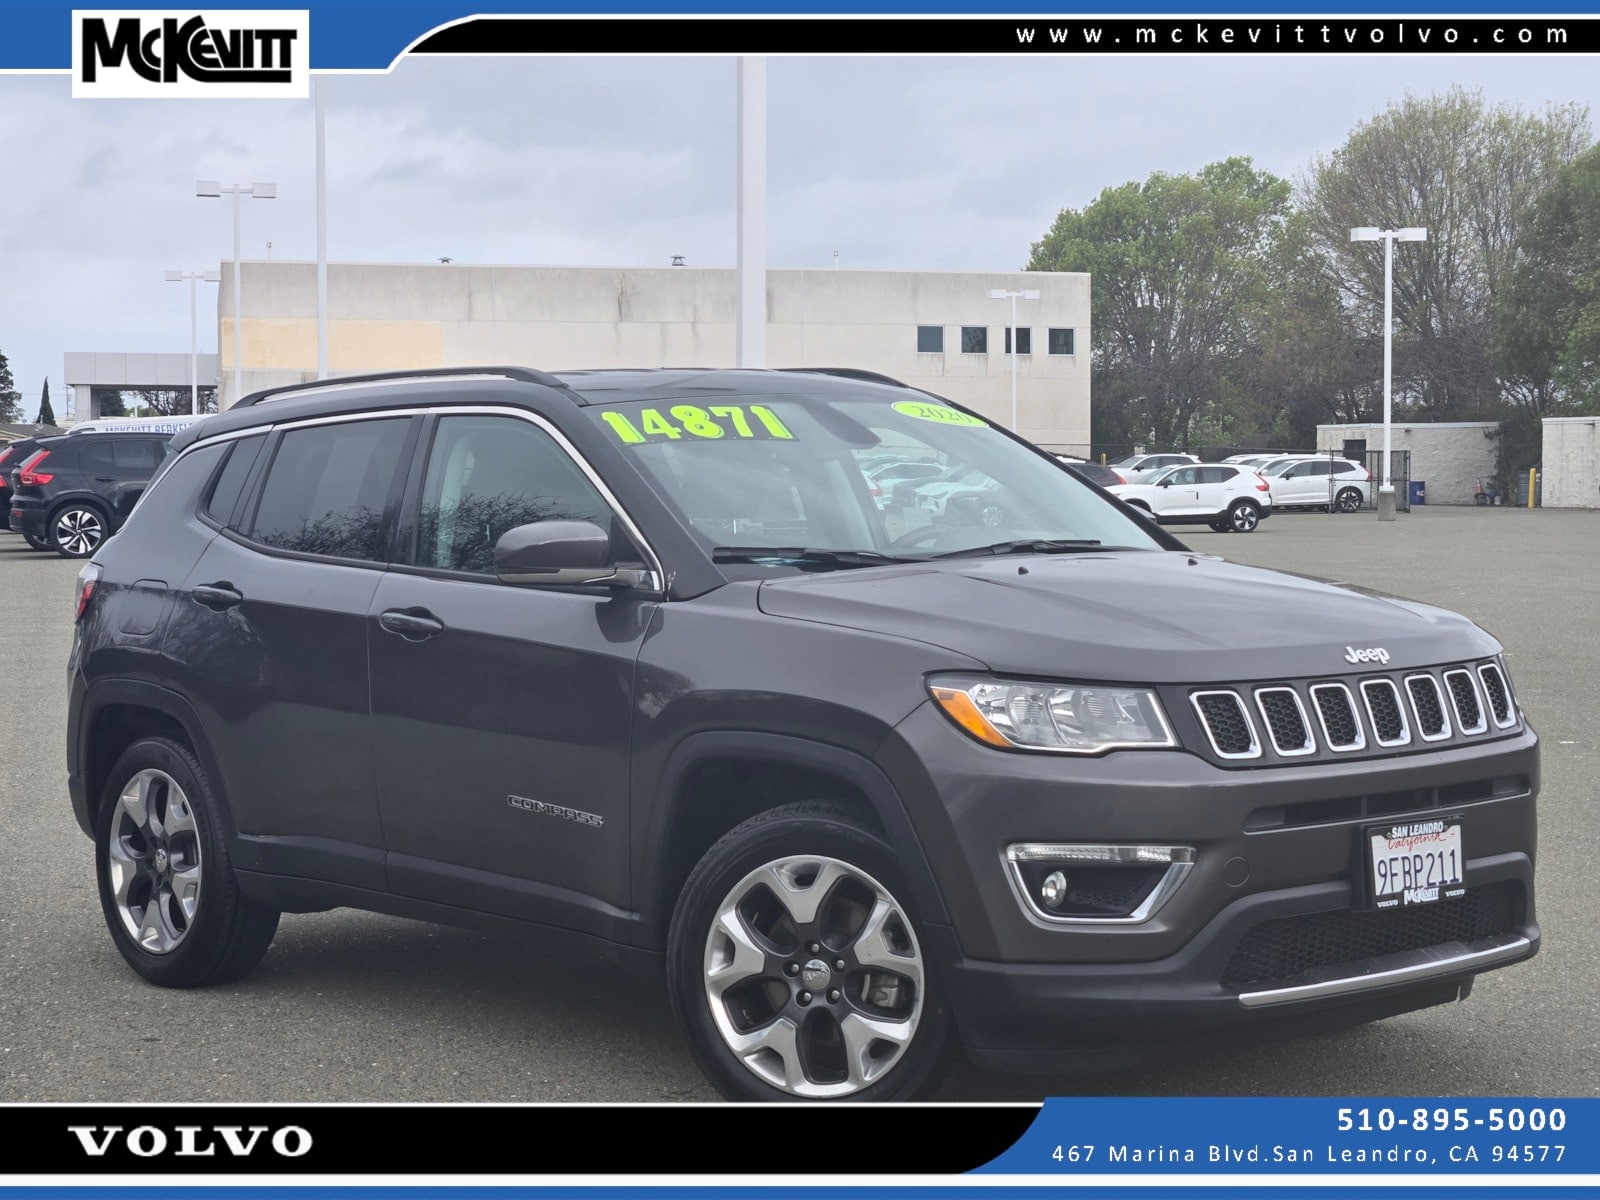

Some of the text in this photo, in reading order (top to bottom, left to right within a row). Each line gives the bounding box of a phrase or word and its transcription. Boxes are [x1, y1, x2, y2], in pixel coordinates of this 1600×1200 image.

[155, 423, 193, 434] BERKE
[601, 405, 794, 443] 14871
[1344, 646, 1390, 665] Jeep
[507, 795, 604, 828] COMPASS
[1391, 821, 1444, 839] SAN LEANDRO
[1377, 849, 1460, 895] 9FBP211
